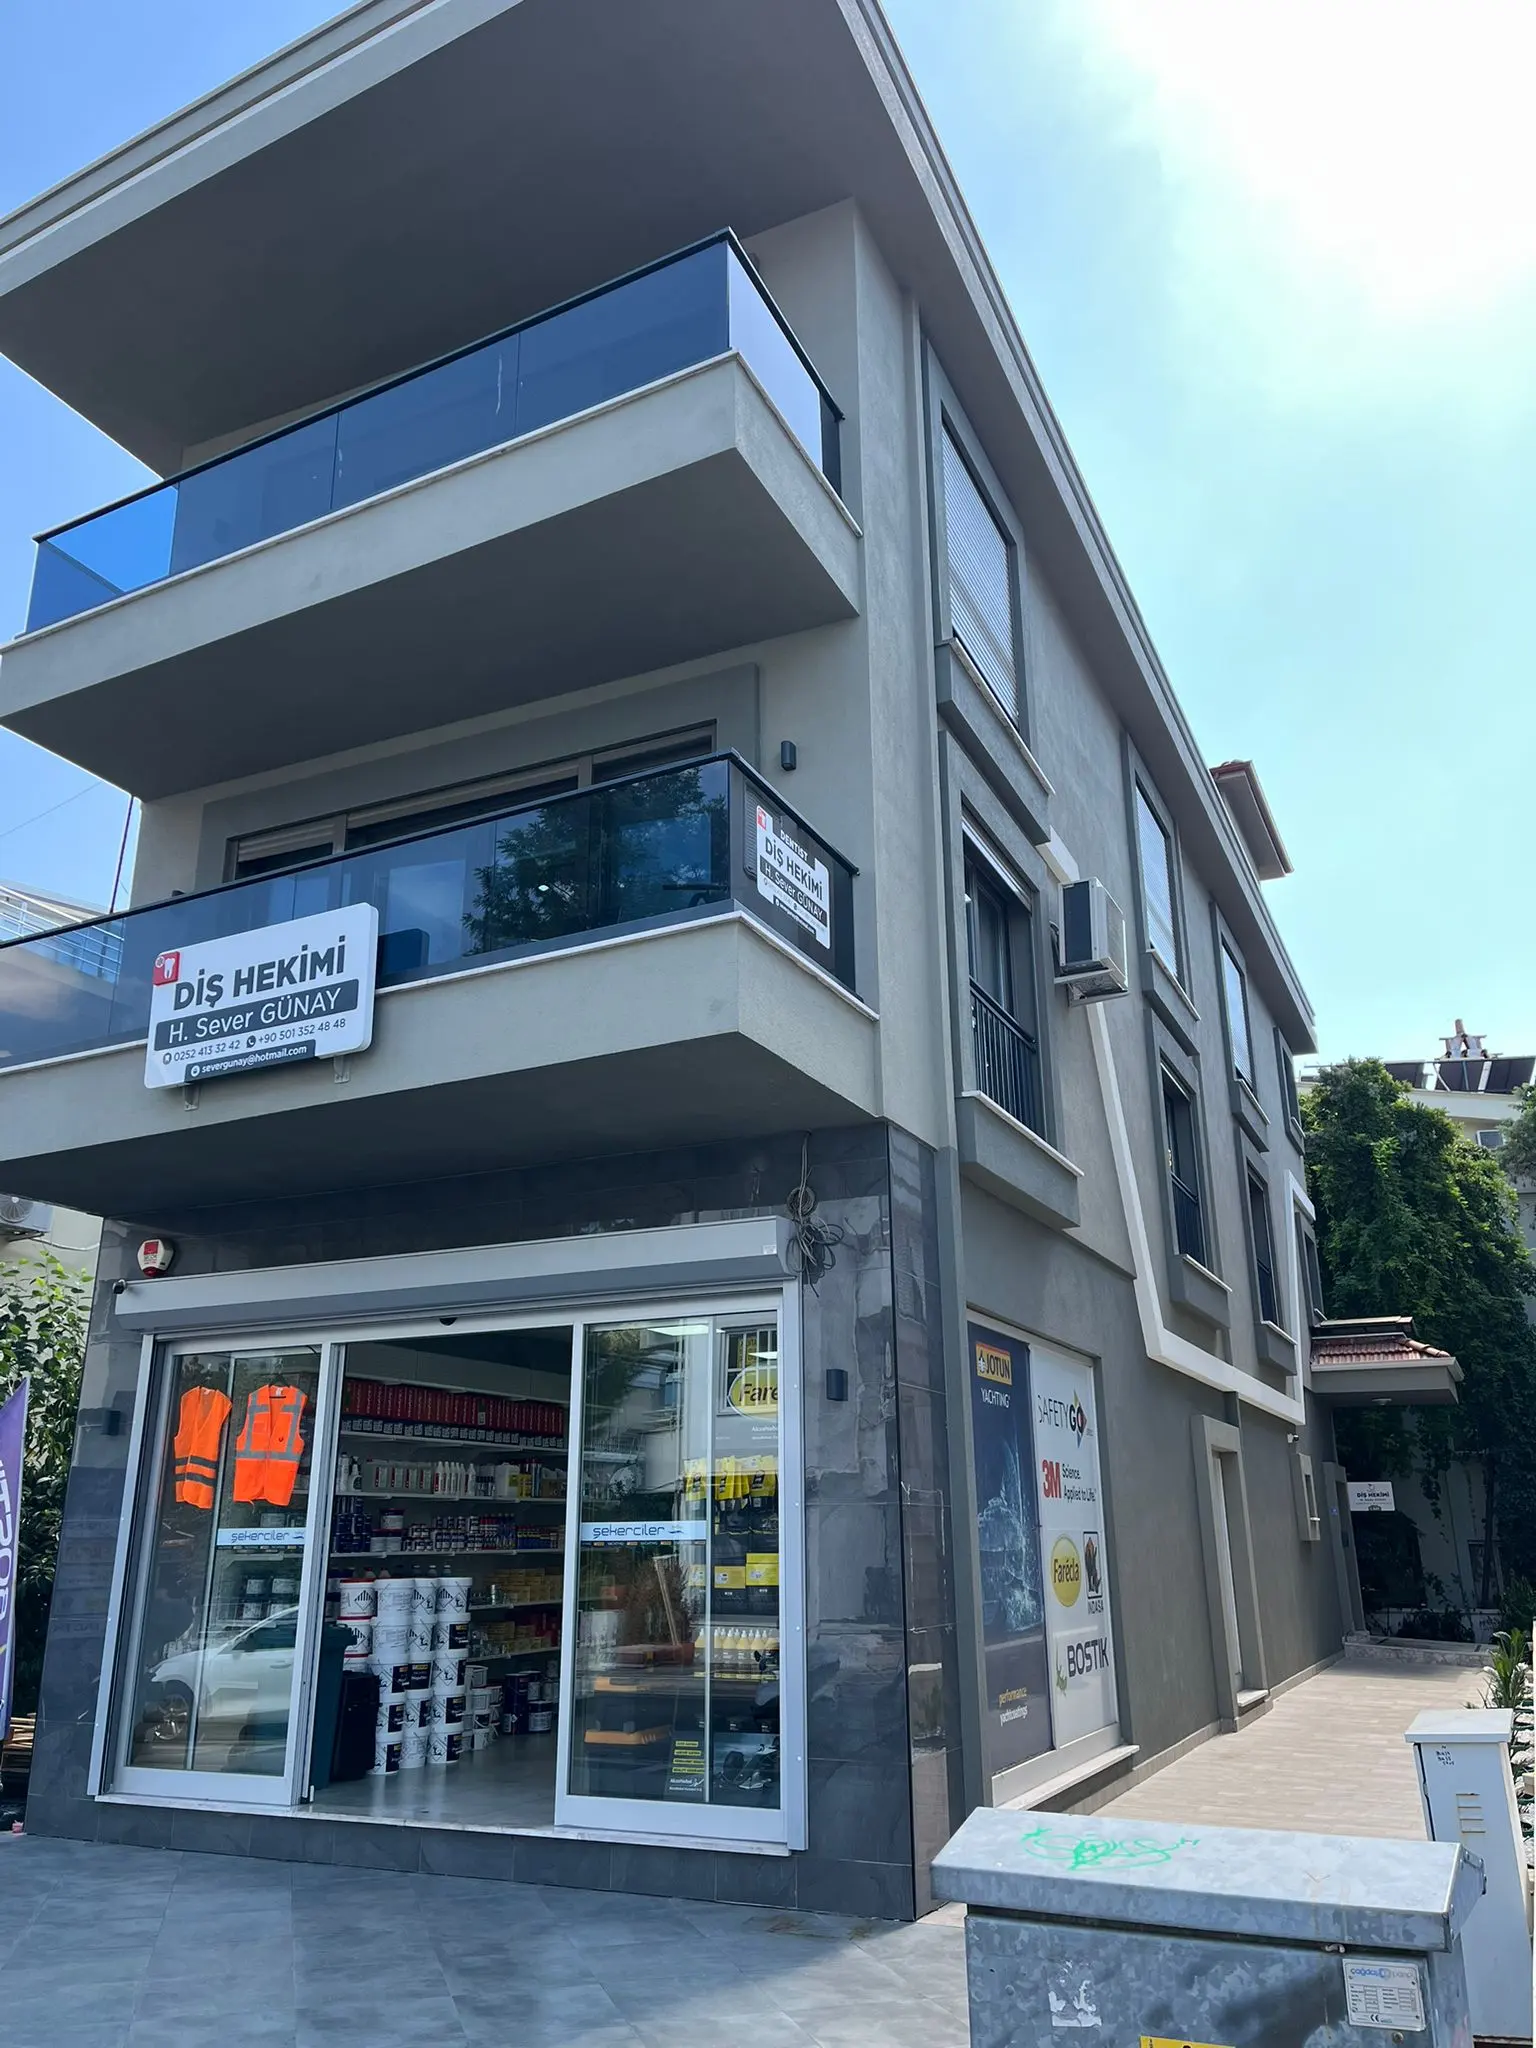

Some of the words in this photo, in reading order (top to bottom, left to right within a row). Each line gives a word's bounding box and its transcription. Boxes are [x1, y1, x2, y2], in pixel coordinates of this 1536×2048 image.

[765, 836, 784, 868] DİŞ
[787, 855, 823, 900] HEKİMİ
[765, 863, 773, 880] H.
[774, 871, 796, 898] Sever
[174, 968, 224, 1011] DİŞ
[233, 935, 346, 998] HEKİMİ
[169, 1024, 188, 1044] H.
[195, 1010, 253, 1038] Sever
[260, 988, 342, 1024] GÜNAY
[258, 1031, 277, 1044] +90
[279, 1027, 296, 1041] 501
[298, 1024, 316, 1037] 352
[317, 1021, 331, 1032] 48
[333, 1018, 346, 1029] 48
[174, 1048, 196, 1062] 0252
[198, 1045, 213, 1056] 413
[214, 1042, 226, 1054] 32
[228, 1039, 241, 1051] 42
[201, 1045, 307, 1074] severgunay@hotmail.com
[986, 1353, 1011, 1379] JOTUN
[980, 1387, 1011, 1408] YACHTING
[1042, 1459, 1062, 1499] 3M
[231, 1530, 289, 1543] şekerciler
[593, 1524, 665, 1539] şekerciler
[1053, 1558, 1080, 1583] Farécla
[1067, 1637, 1109, 1677] BOSTIK
